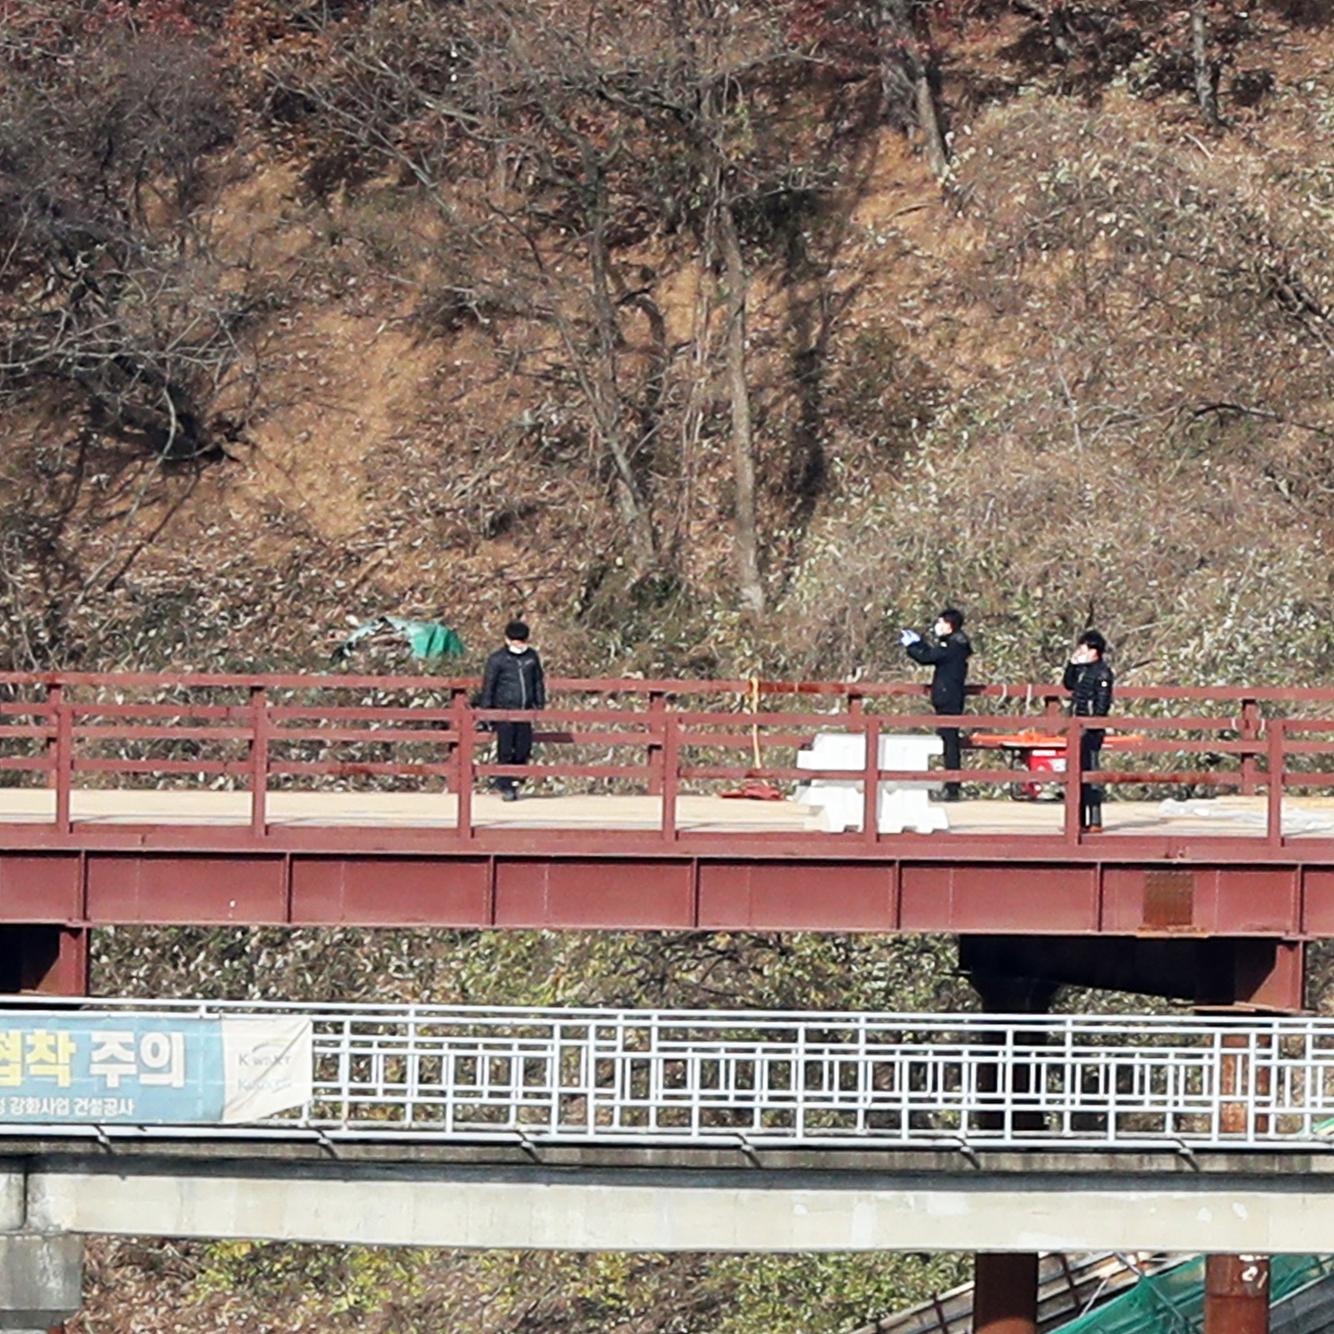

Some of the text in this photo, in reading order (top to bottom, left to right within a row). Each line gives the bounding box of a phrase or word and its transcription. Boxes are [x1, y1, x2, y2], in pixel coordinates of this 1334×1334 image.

[89, 1031, 185, 1088] 주의
[10, 1096, 70, 1117] 강화사업
[74, 1098, 135, 1118] 건설공사
